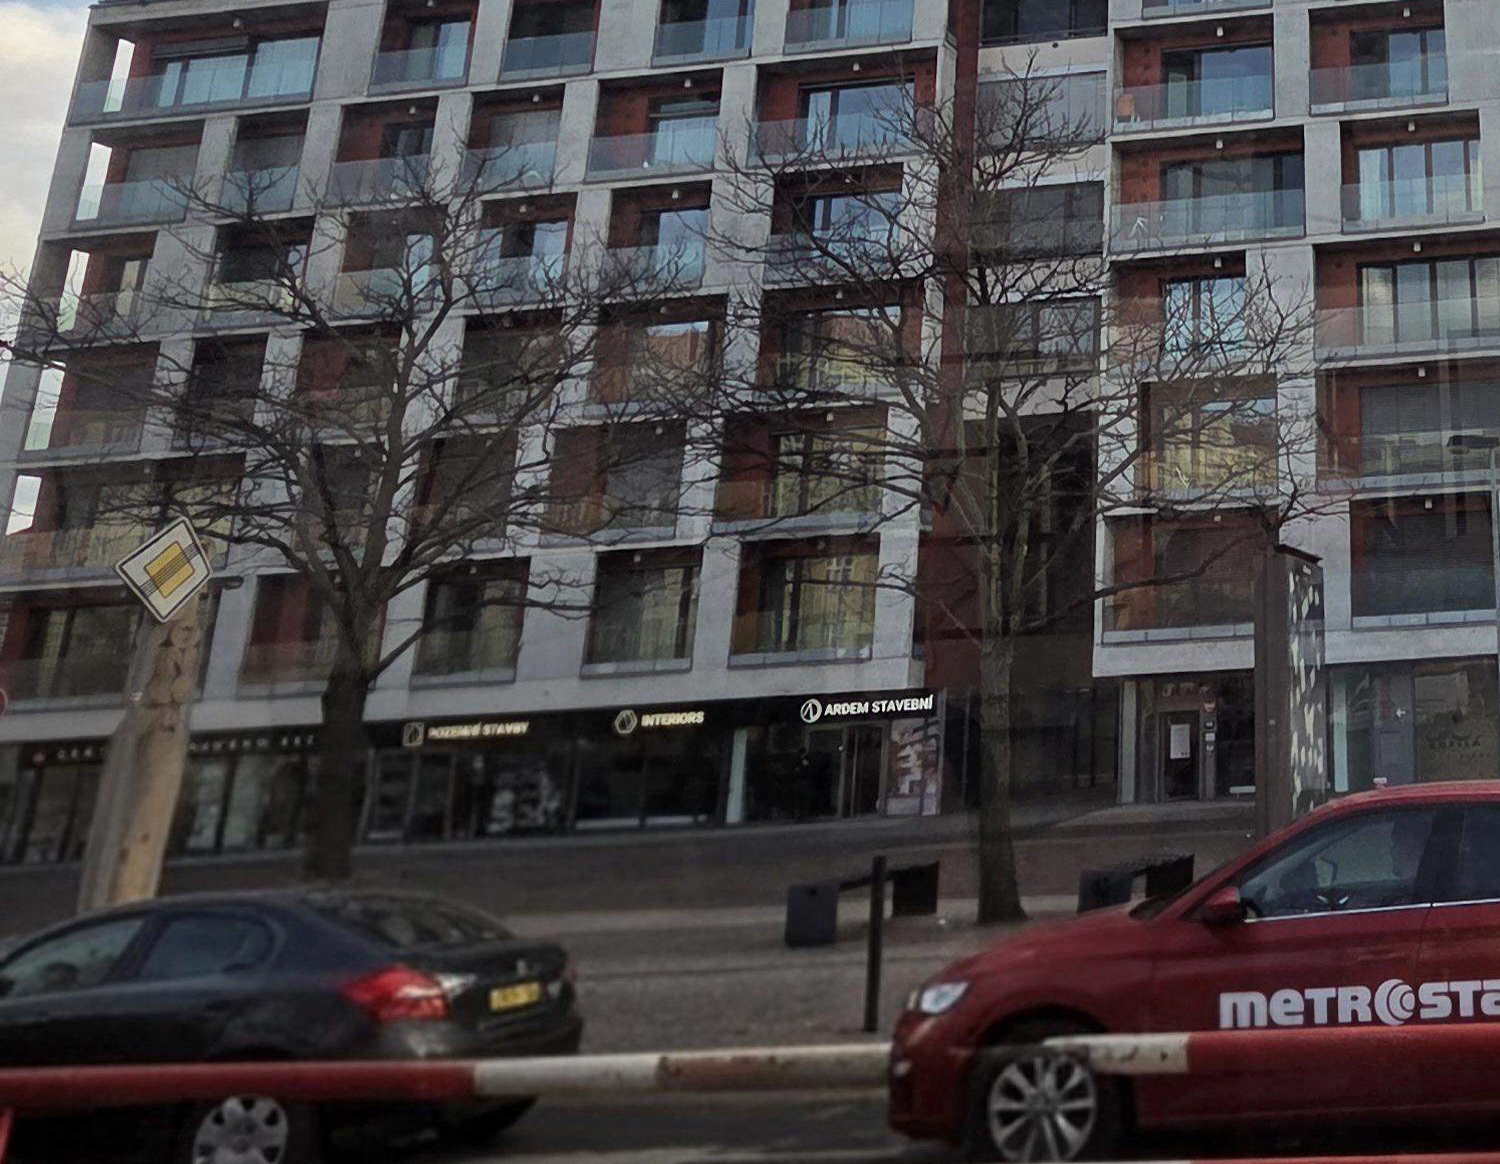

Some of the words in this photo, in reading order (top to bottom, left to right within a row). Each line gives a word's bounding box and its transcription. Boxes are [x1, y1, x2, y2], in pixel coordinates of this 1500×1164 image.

[824, 701, 869, 716] ARDEM
[871, 694, 933, 713] STAVEBNÍ
[641, 711, 704, 727] INTERIORS
